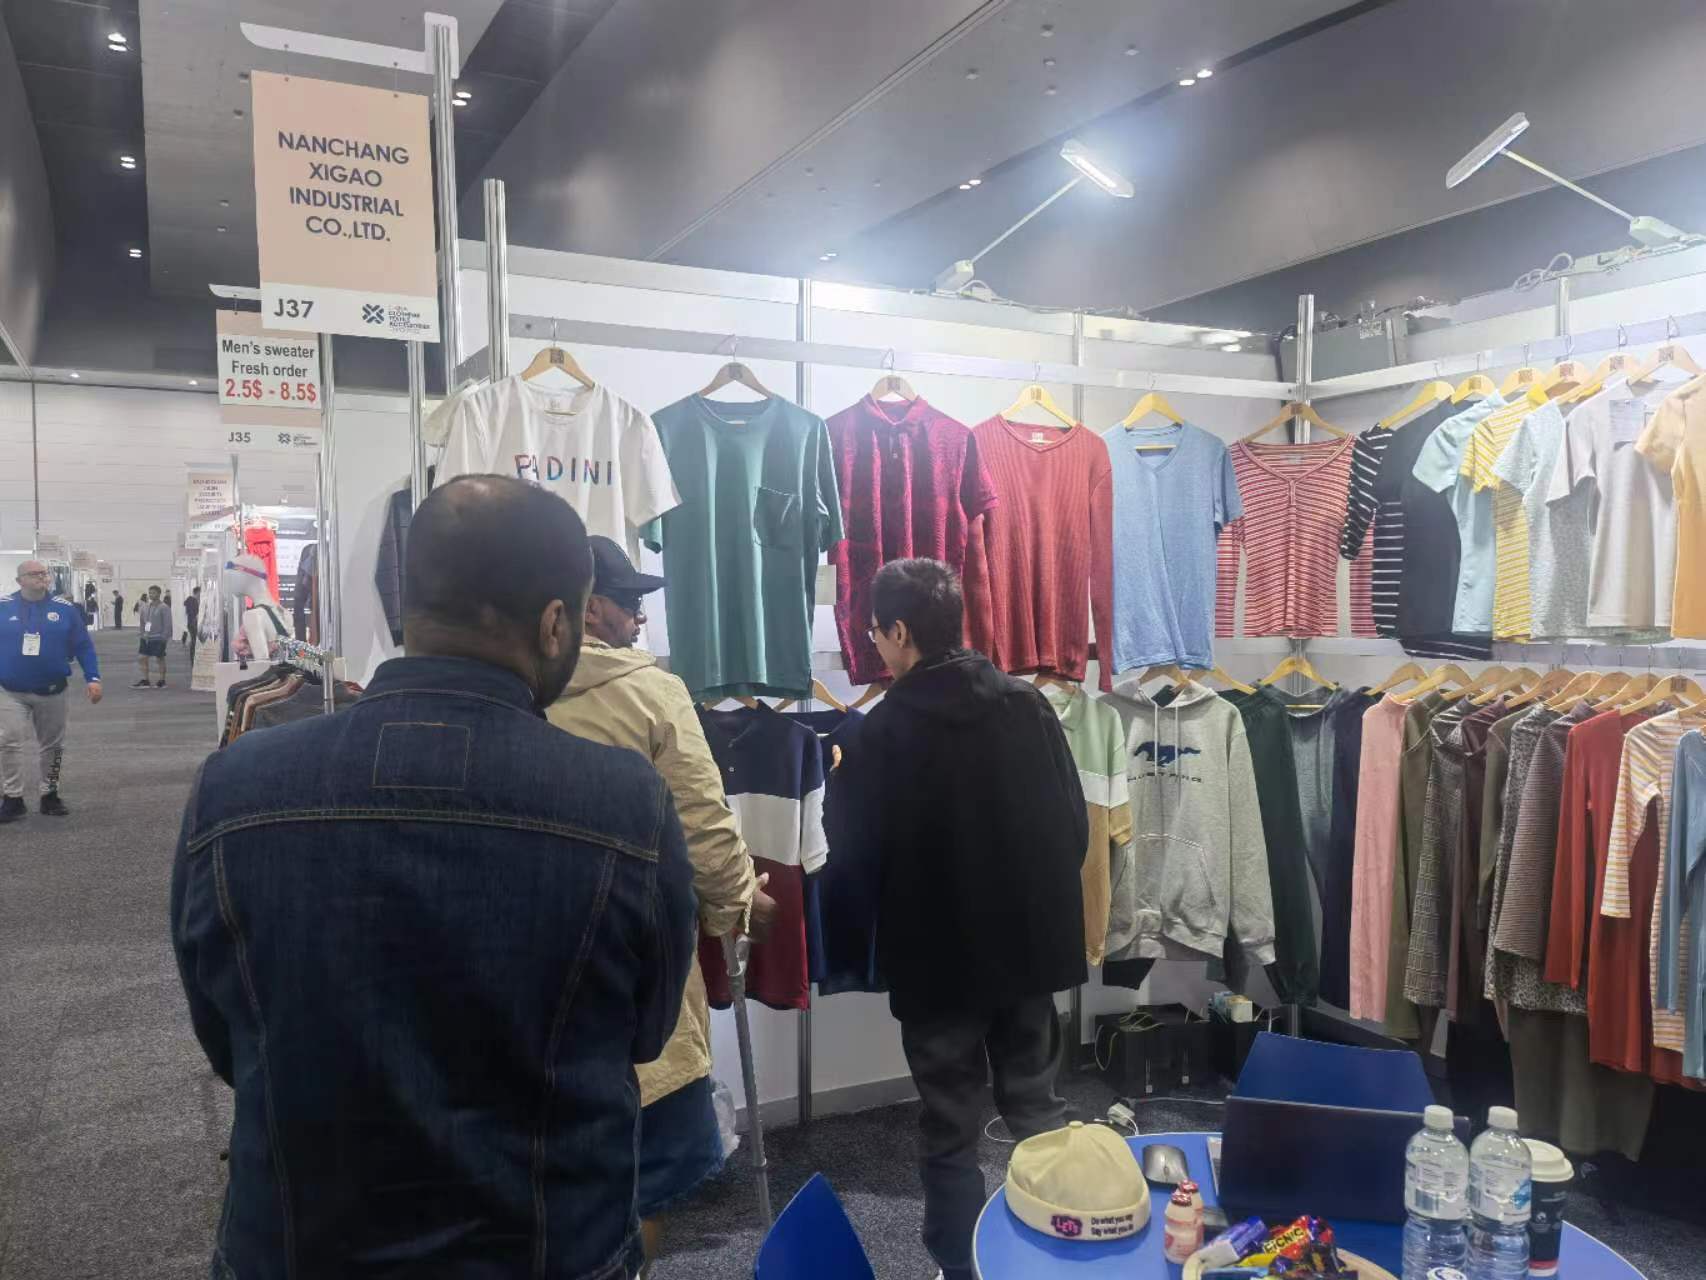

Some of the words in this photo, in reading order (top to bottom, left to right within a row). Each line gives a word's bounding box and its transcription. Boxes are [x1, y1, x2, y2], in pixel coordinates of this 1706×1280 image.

[278, 130, 409, 165] NANCHANG
[309, 162, 382, 188] XIGAO
[289, 187, 404, 217] INDUSTRIAL
[306, 216, 391, 242] CO.,LTD.
[273, 298, 314, 318] J37
[222, 339, 261, 355] Men's
[264, 345, 315, 358] sweater
[232, 360, 269, 376] Fresh
[273, 364, 308, 377] order
[225, 378, 263, 400] 2.5$
[280, 381, 317, 403] 8.5$
[228, 431, 251, 443] J35
[514, 454, 613, 485] PADINI
